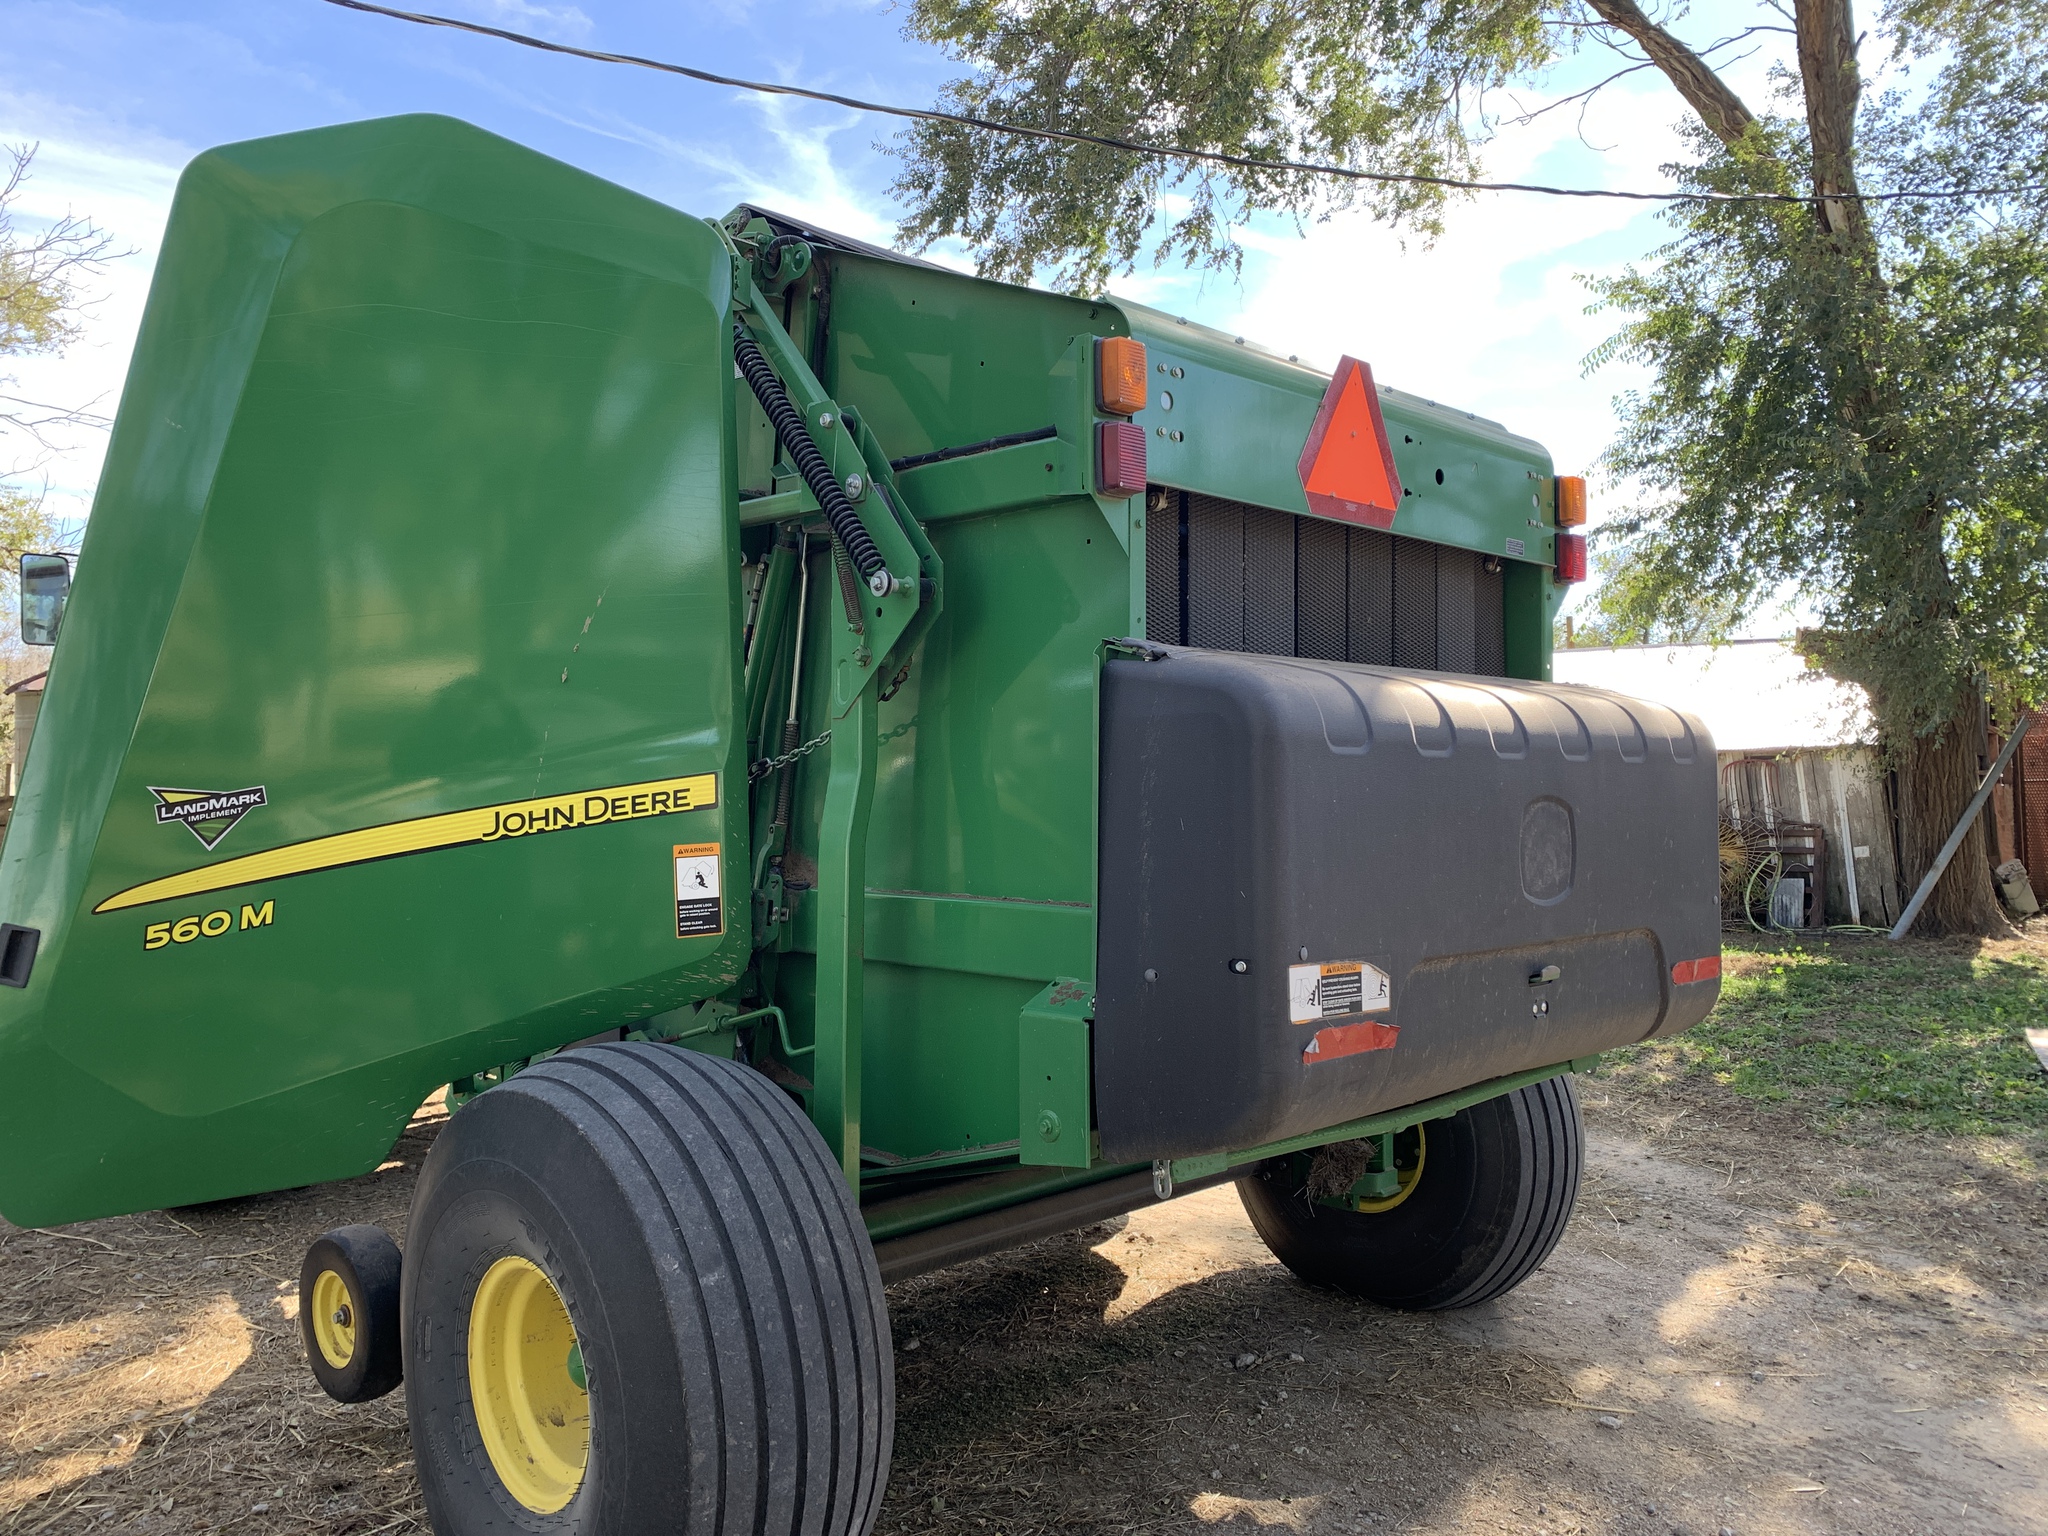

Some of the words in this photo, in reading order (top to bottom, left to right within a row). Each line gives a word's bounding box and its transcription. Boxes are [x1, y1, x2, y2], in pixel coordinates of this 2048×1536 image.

[188, 807, 243, 823] IMPLEMENT
[482, 804, 574, 838] JOHN
[584, 788, 691, 821] DEERE
[683, 846, 714, 854] WARNING
[144, 909, 233, 951] 560
[239, 899, 276, 932] M
[1332, 964, 1356, 972] WARNING
